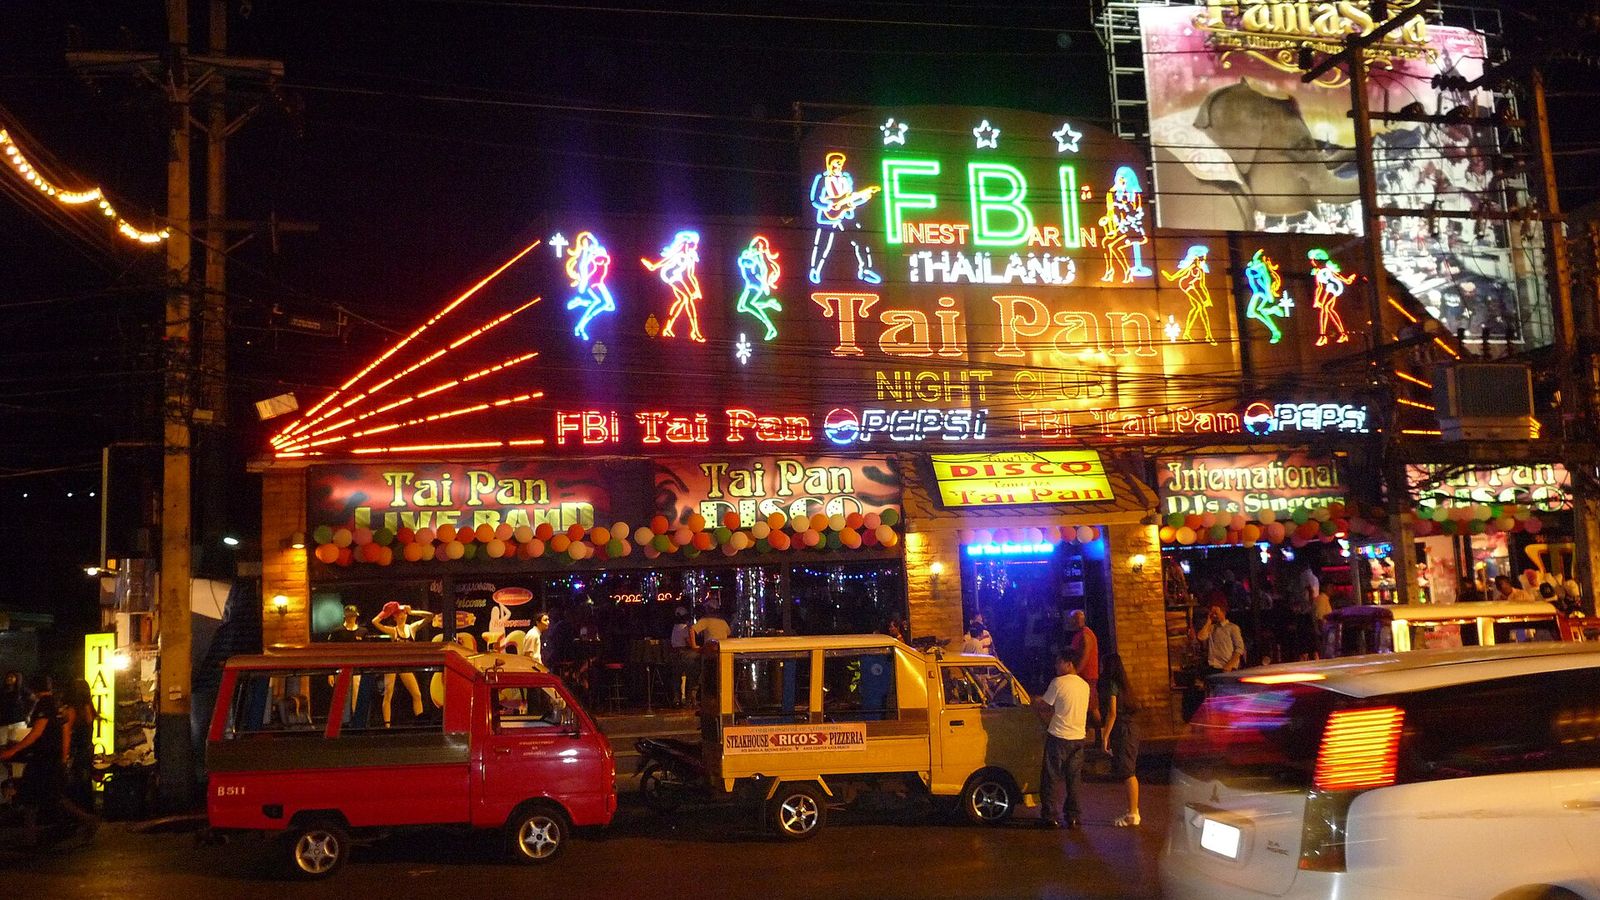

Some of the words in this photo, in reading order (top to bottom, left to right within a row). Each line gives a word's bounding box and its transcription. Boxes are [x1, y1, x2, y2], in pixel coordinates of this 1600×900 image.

[1301, 39, 1345, 54] Cultura
[909, 251, 1076, 284] THAILAND
[811, 292, 964, 357] Tai
[992, 295, 1159, 358] Pan
[876, 371, 993, 401] NIGHT
[1013, 371, 1108, 401] CLUB
[635, 410, 709, 443] Tai
[725, 409, 813, 442] Pan
[1018, 408, 1072, 439] FBI
[1088, 408, 1159, 438] Tai
[1170, 407, 1241, 434] Pan
[699, 462, 767, 499] Tai
[776, 460, 854, 496] Pan
[950, 461, 1092, 478] DISCO
[1168, 460, 1339, 491] International
[1488, 462, 1557, 487] Pan
[382, 470, 454, 507] Tai
[466, 471, 551, 506] Pan
[1029, 487, 1106, 503] Pan
[1419, 486, 1565, 512] DISCO
[354, 507, 461, 536] LIVE
[473, 502, 594, 534] BAND
[700, 496, 863, 529] DISCO
[1226, 503, 1239, 513] &
[1243, 494, 1345, 515] Singers
[91, 645, 109, 766] TATTO
[726, 735, 769, 748] STEAKHOUSE
[779, 734, 818, 746] RICO'S
[829, 731, 864, 745] PIZZERIA
